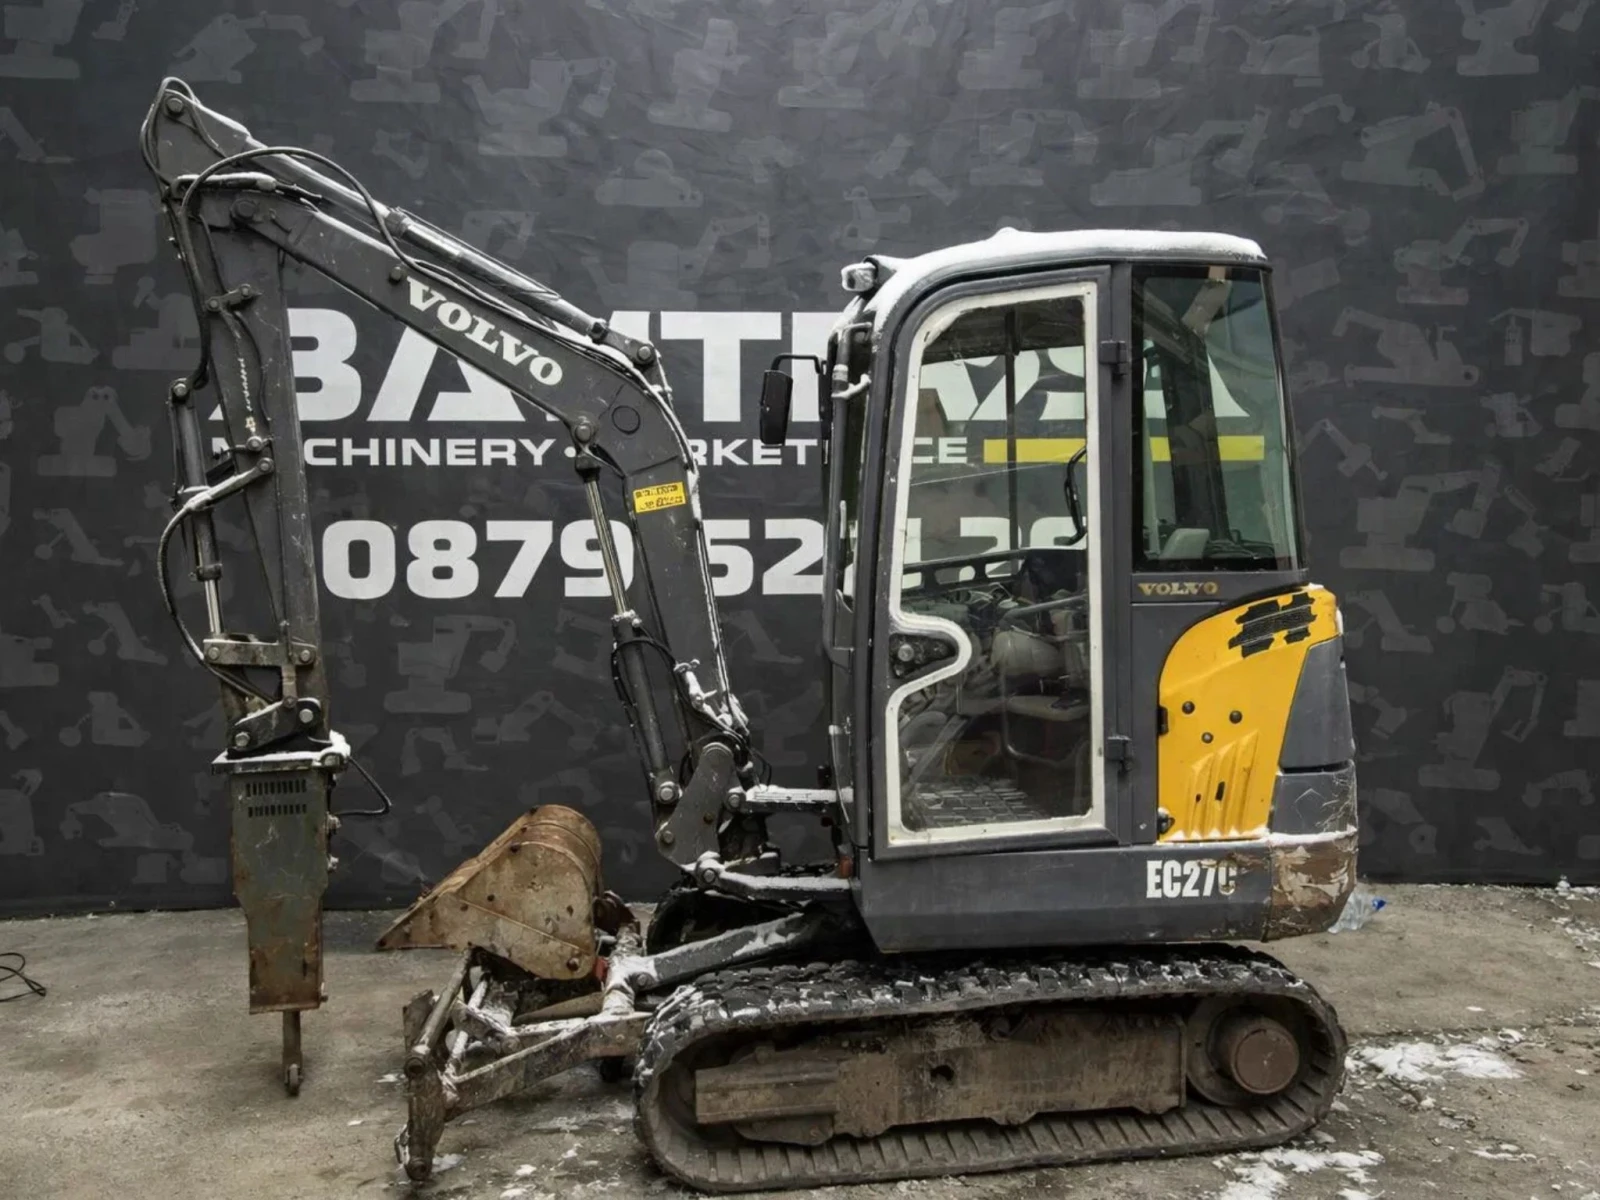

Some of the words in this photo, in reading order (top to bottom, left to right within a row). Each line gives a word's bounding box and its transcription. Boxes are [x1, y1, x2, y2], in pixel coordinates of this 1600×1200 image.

[407, 276, 563, 385] VOLVO
[211, 436, 557, 466] CHINERY
[322, 519, 634, 599] 0879
[1138, 582, 1219, 595] VOLVO
[1146, 859, 1238, 898] EC27C
